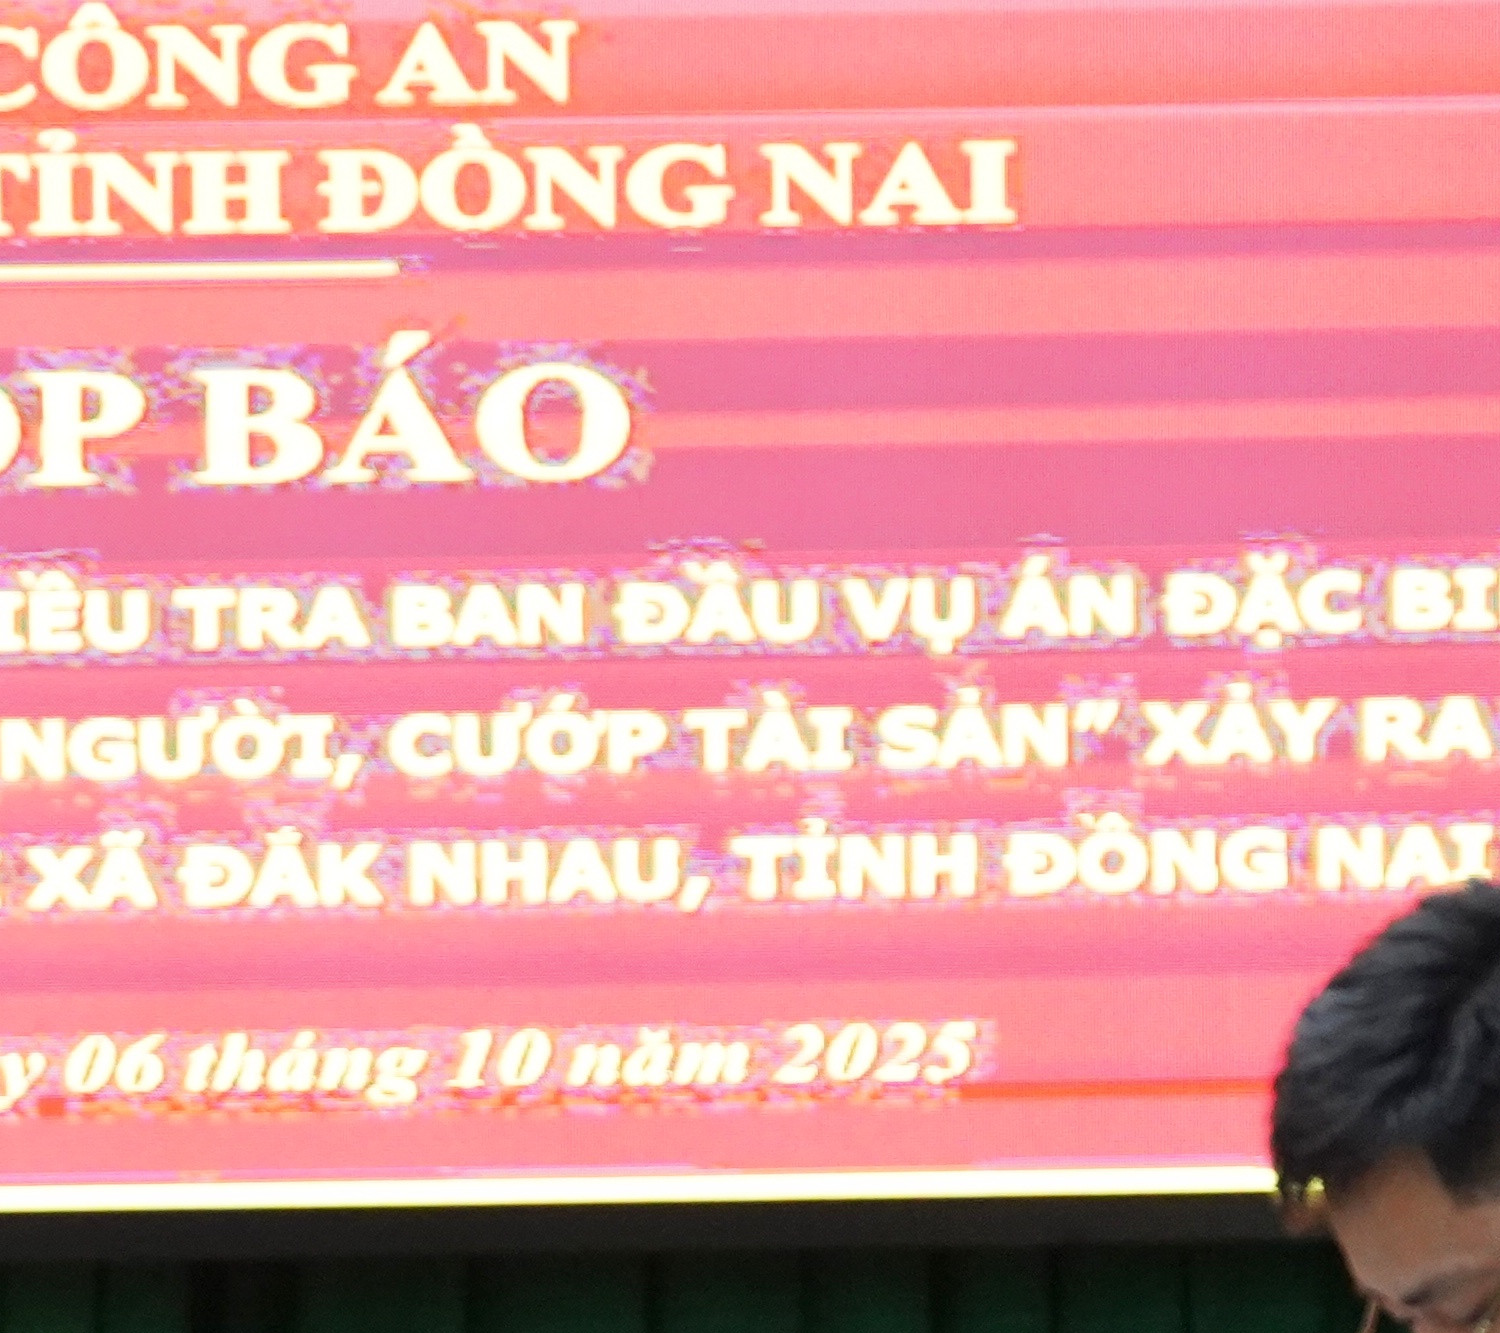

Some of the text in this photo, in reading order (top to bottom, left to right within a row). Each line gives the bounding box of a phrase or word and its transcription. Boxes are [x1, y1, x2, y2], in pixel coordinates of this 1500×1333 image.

[381, 20, 574, 101] AN
[321, 123, 730, 231] ĐỒNG
[765, 141, 1013, 225] NAI
[193, 330, 630, 485] BÁO
[172, 584, 370, 650] TRA
[393, 581, 584, 648] BAN
[614, 559, 819, 645] ĐẦU
[843, 575, 975, 654] VỤ
[1000, 554, 1135, 638] ÁN
[1163, 549, 1363, 649] ĐẶC
[0, 696, 361, 788] NGƯỜI,
[388, 691, 663, 780] CƯỚP
[683, 688, 853, 774] TÀI
[1145, 681, 1333, 765] XẢY
[1362, 696, 1493, 762] RA
[27, 825, 157, 910] XÃ
[408, 835, 710, 910] NHAU,
[729, 815, 978, 901] TỈNH
[1000, 809, 1289, 896] ĐỒNG
[1317, 821, 1495, 891] NAI
[64, 1032, 164, 1093] 06
[185, 1029, 429, 1105] tháng
[455, 1027, 552, 1089] 10
[568, 1024, 750, 1086] năm
[775, 1019, 977, 1086] 2025
